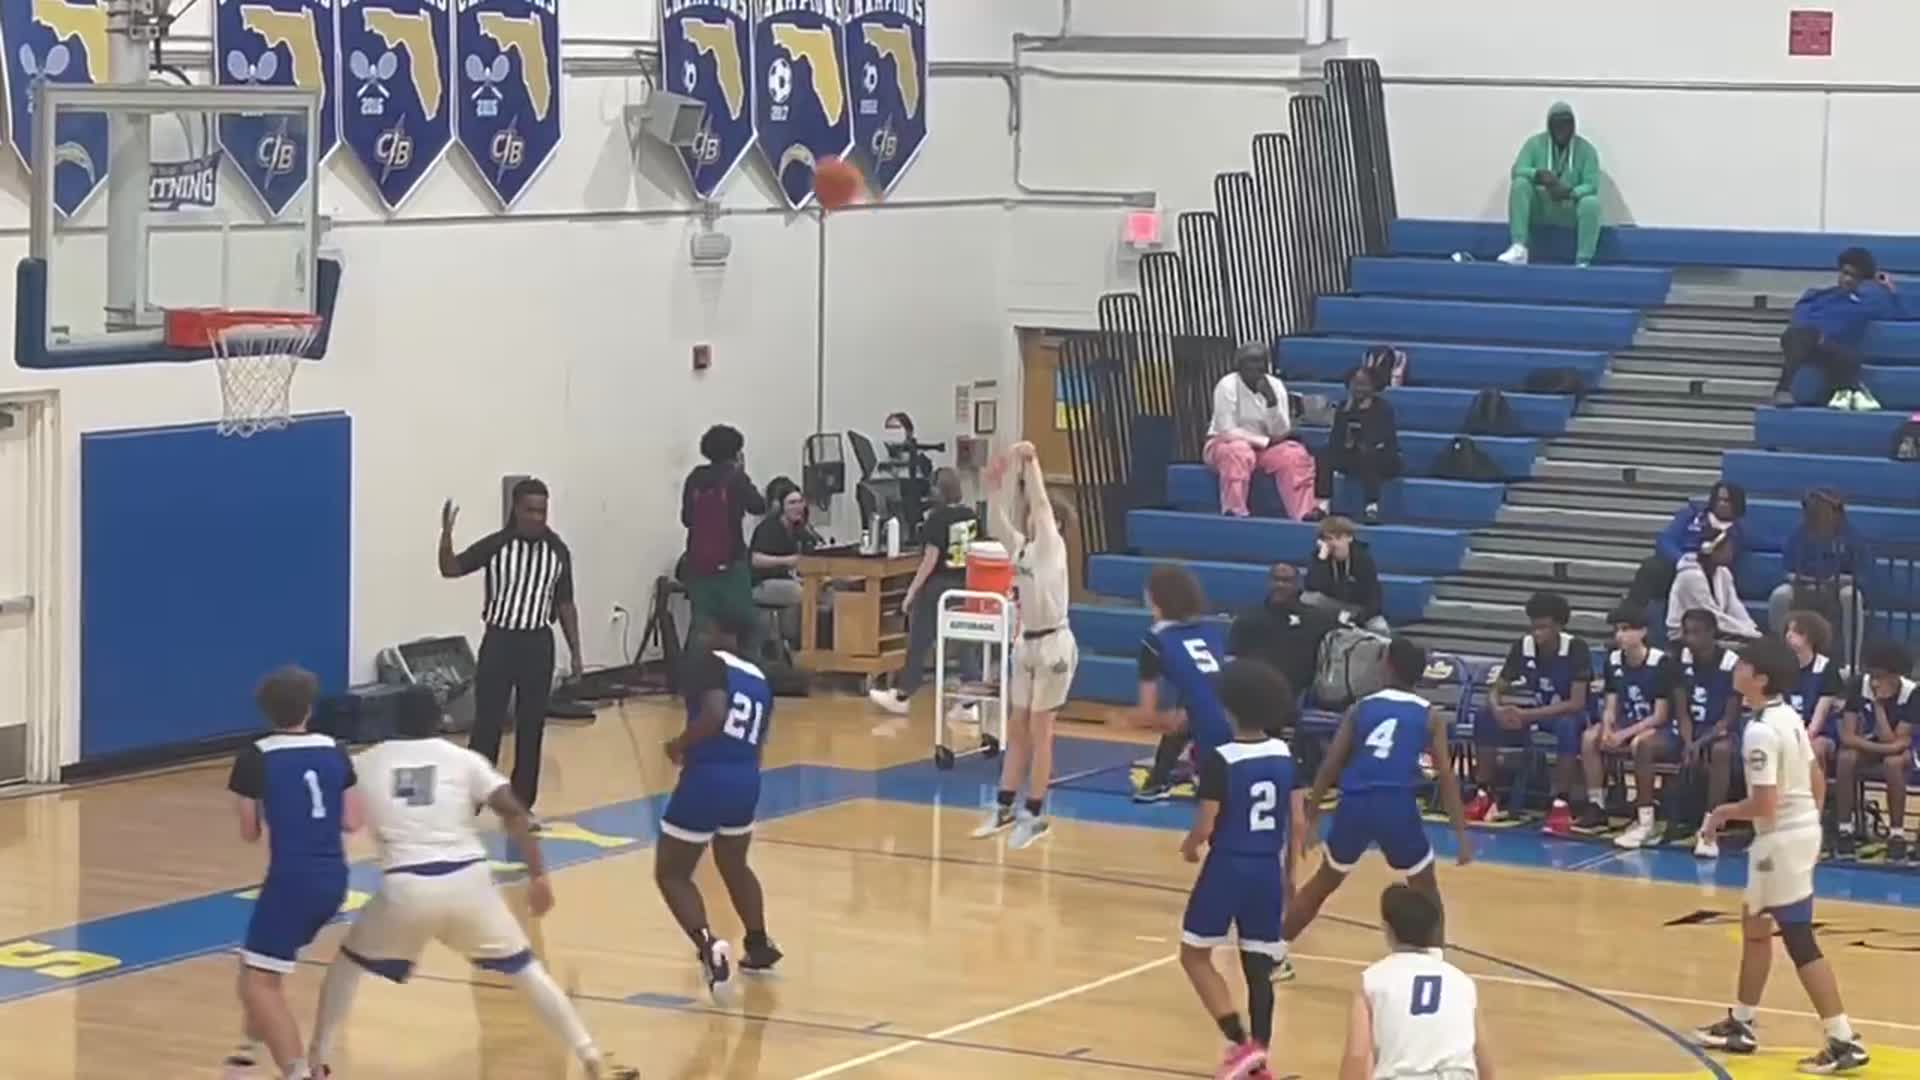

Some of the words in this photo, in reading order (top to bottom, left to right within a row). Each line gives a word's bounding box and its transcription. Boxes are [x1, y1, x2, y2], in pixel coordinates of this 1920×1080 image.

[1183, 638, 1220, 673] 5
[723, 691, 763, 744] 21
[1365, 718, 1398, 759] 4
[303, 769, 326, 818] 1
[1250, 781, 1276, 831] 2
[1410, 975, 1442, 1015] 0
